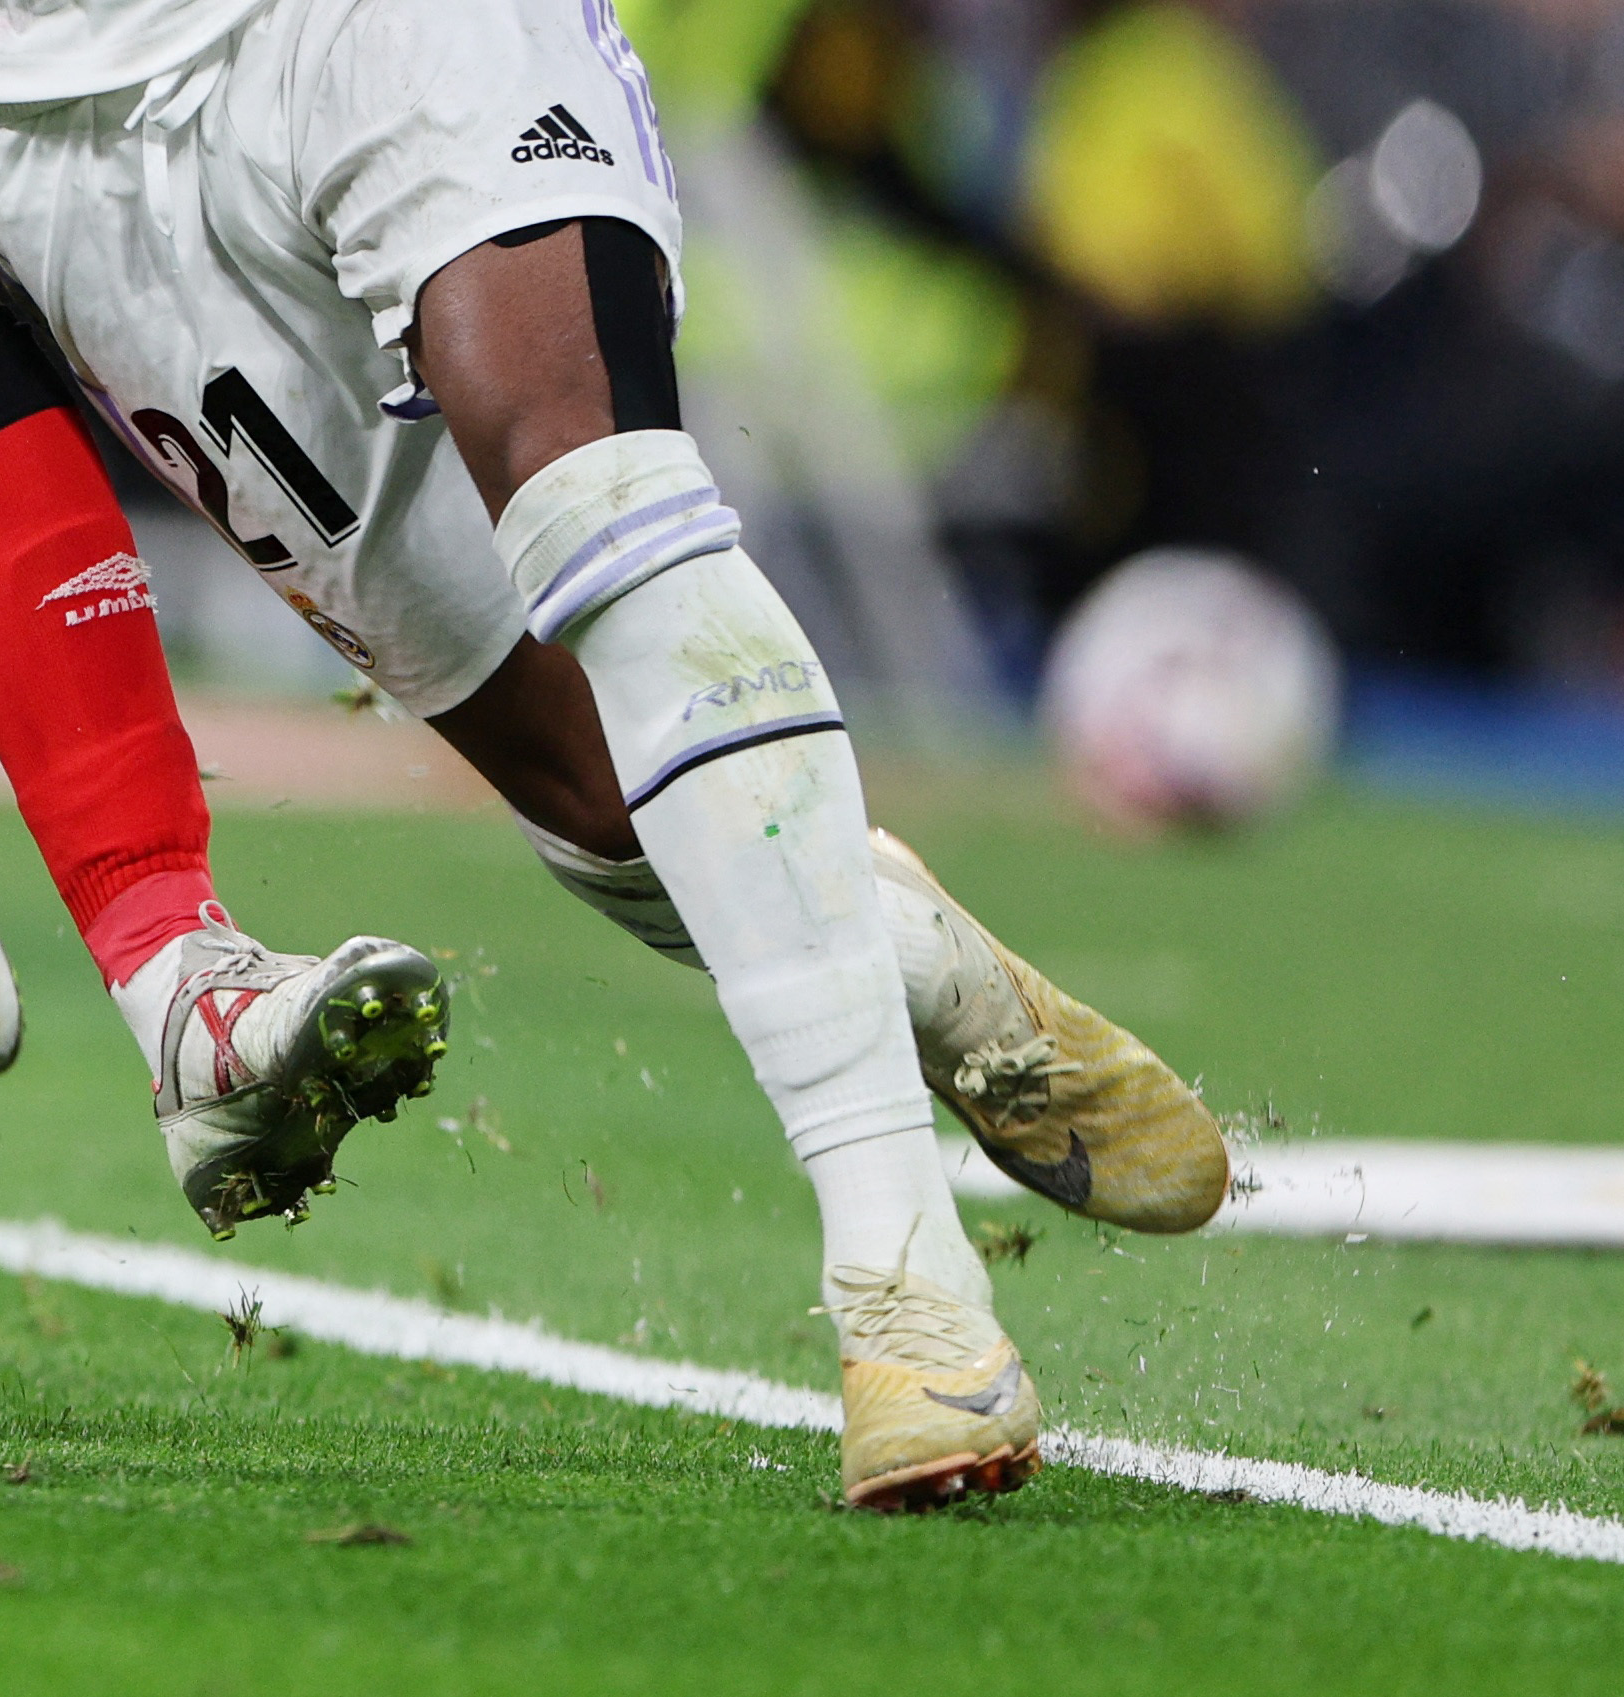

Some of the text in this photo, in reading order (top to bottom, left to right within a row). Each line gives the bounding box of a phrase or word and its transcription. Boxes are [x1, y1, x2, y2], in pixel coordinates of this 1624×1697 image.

[511, 138, 614, 166] adidas
[131, 366, 361, 572] 21
[682, 660, 821, 723] RMCF
